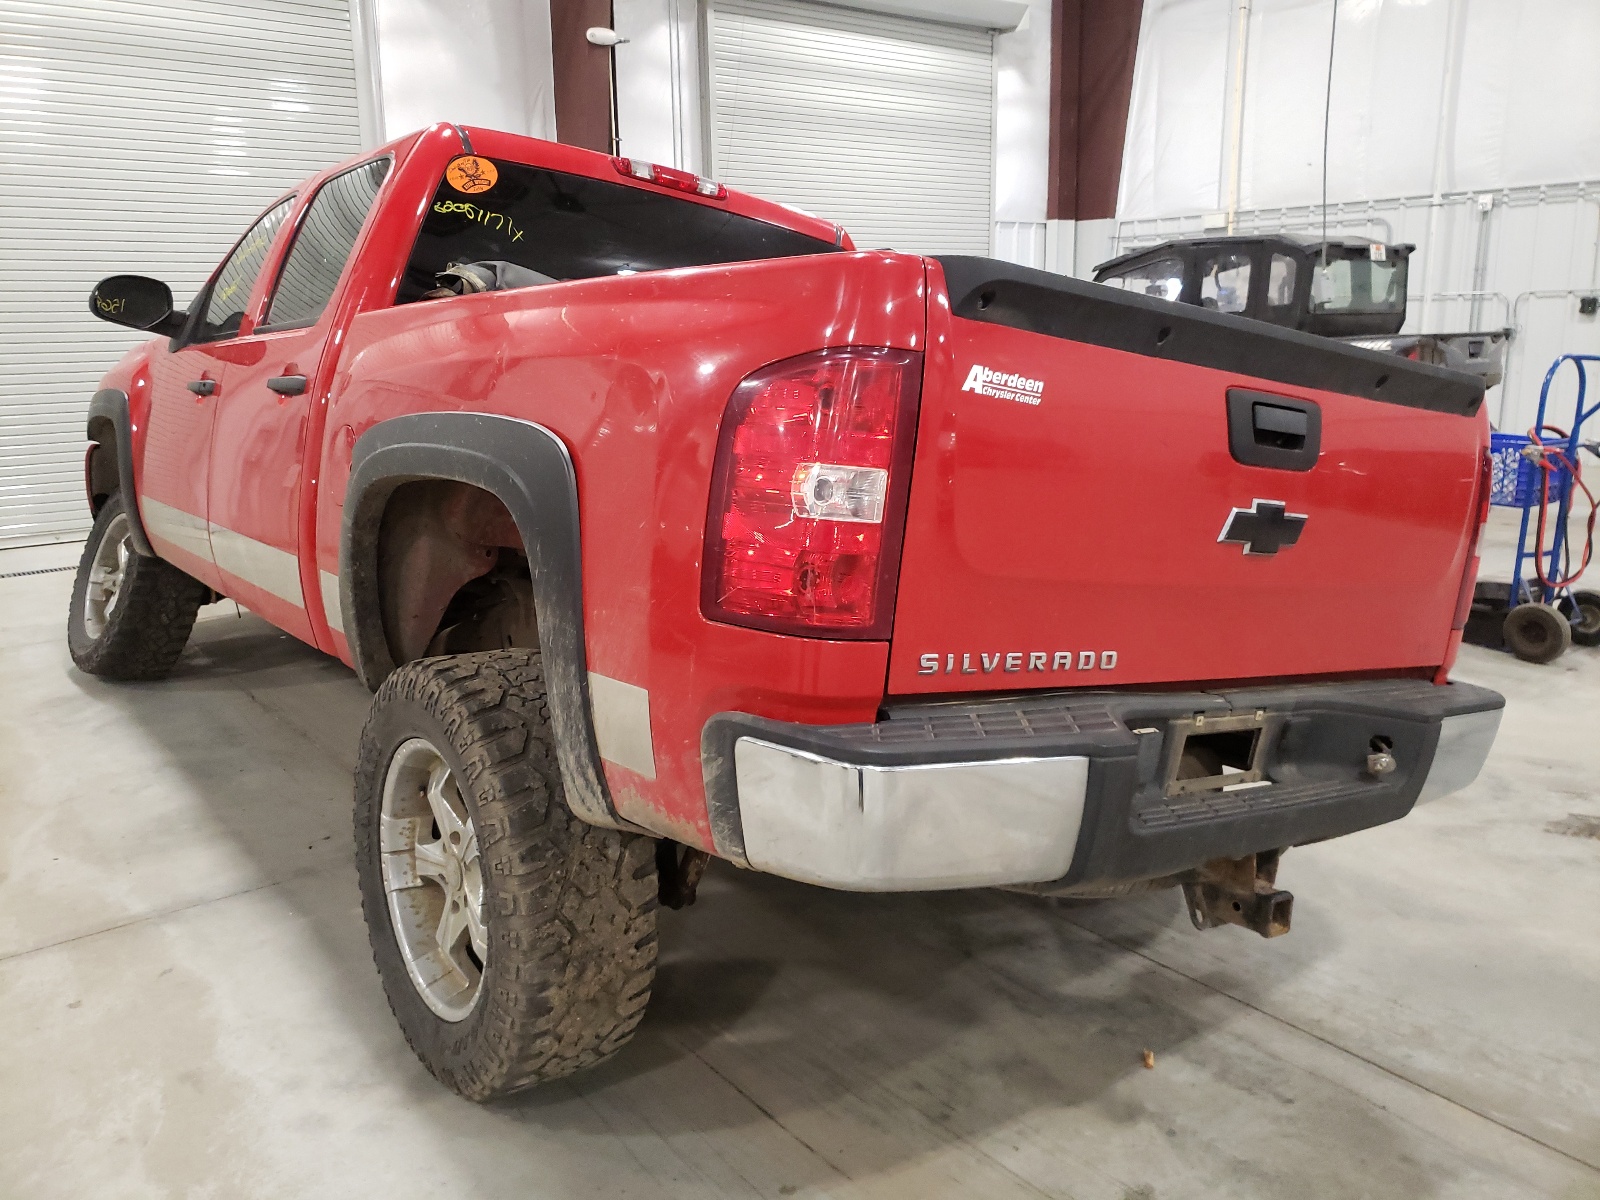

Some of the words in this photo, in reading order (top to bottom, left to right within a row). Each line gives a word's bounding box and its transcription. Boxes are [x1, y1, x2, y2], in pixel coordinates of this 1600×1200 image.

[961, 364, 1044, 394] Aberdeen
[982, 386, 1015, 400] Chrysler
[1015, 393, 1042, 406] Center
[918, 650, 1119, 675] SILVERADO
